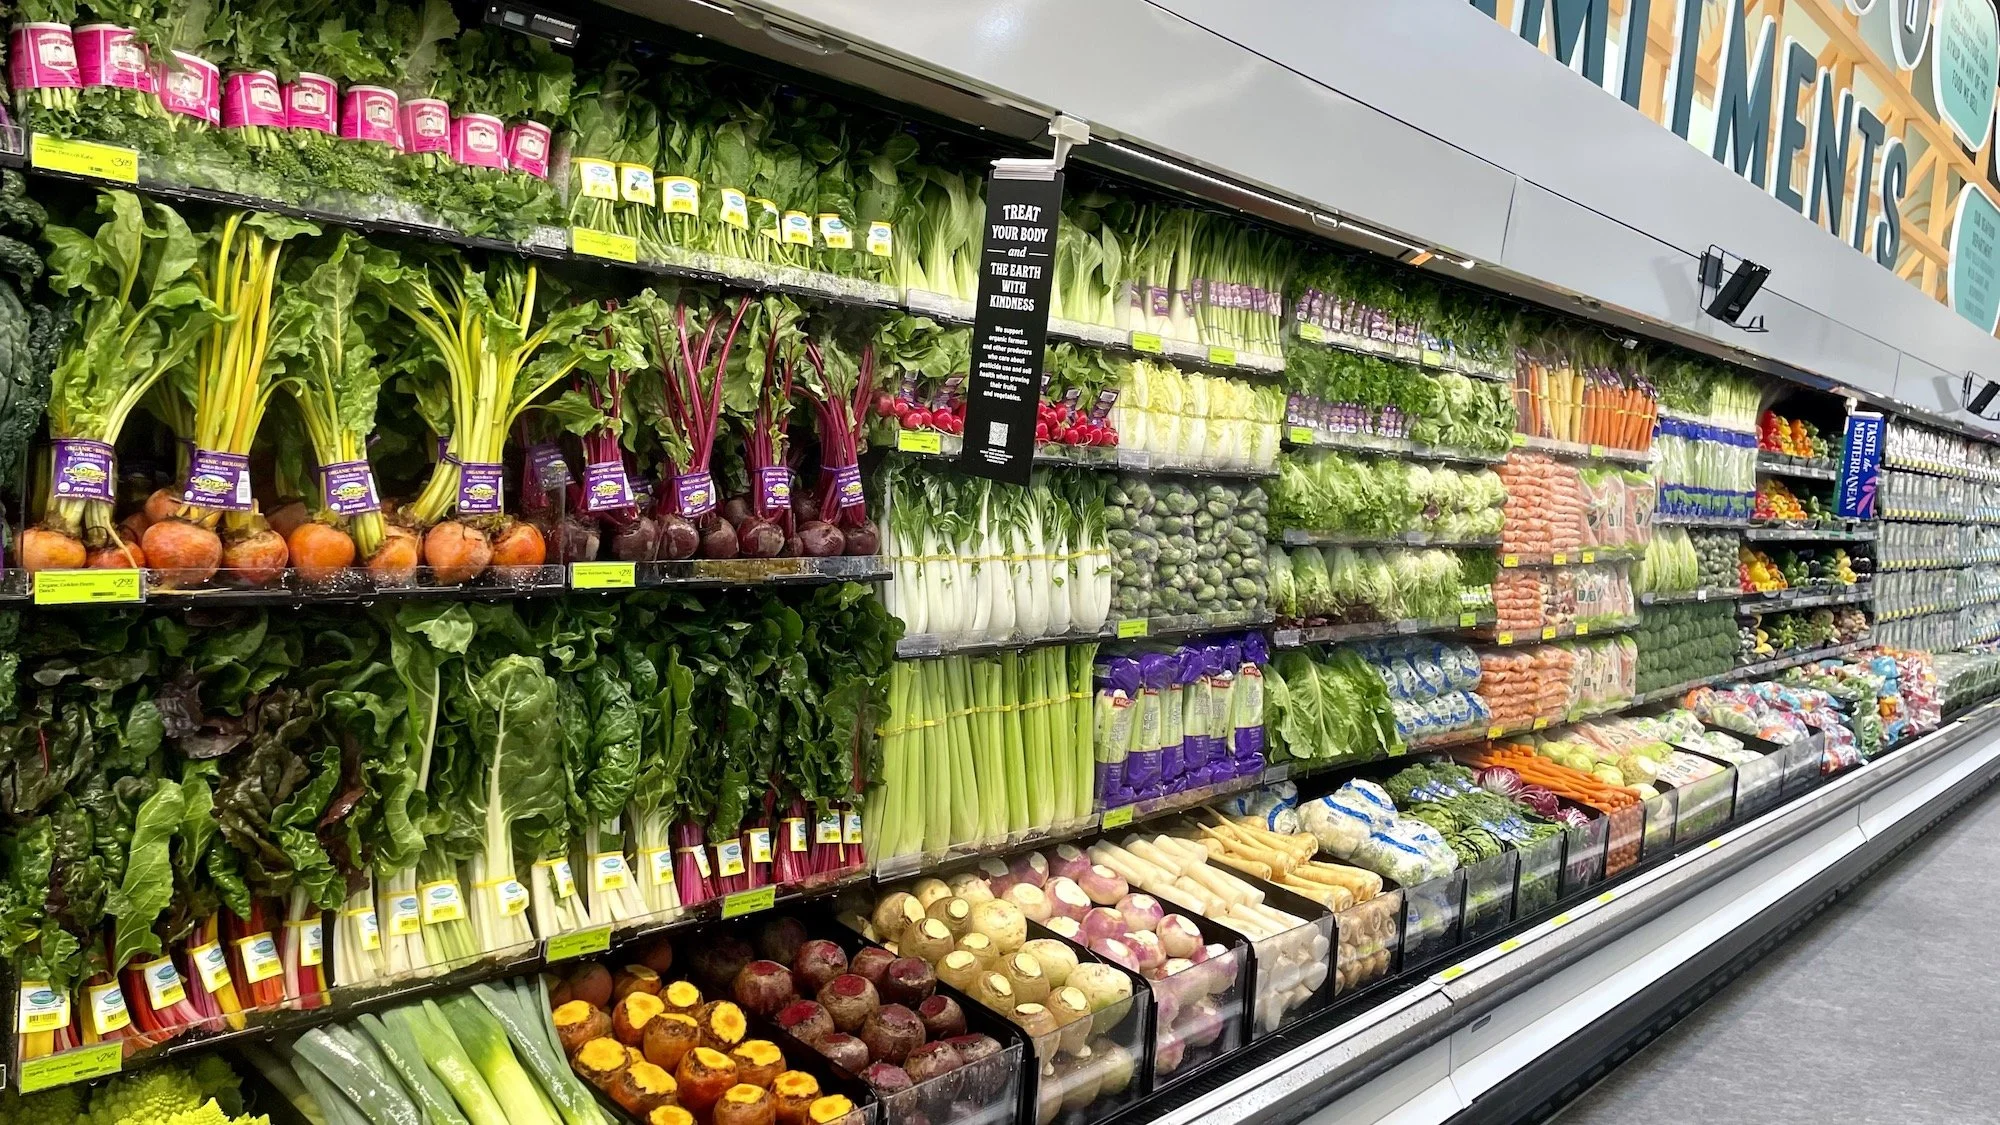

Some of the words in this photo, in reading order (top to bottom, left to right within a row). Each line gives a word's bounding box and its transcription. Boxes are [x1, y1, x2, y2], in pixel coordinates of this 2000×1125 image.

[1003, 204, 1041, 222] TREAT
[992, 224, 1019, 241] YOUR
[1020, 226, 1048, 243] BODY
[1007, 245, 1027, 258] and
[990, 261, 1008, 276] THE
[1009, 263, 1041, 280] EARTH
[1002, 279, 1027, 295] WITH
[989, 294, 1035, 312] KINDNESS
[995, 325, 1003, 333] We
[1003, 327, 1024, 336] support
[988, 335, 1007, 343] organic
[1007, 336, 1028, 345] farmers
[992, 344, 1007, 352] other
[1006, 347, 1033, 356] producers
[987, 353, 998, 361] who
[1010, 356, 1026, 364] about
[979, 361, 1001, 370] pesticide
[1022, 367, 1033, 375] soil
[979, 370, 996, 378] health
[996, 373, 1009, 381] when
[1010, 376, 1030, 385] growing
[989, 380, 1002, 389] their
[1002, 383, 1017, 391] fruits
[993, 391, 1022, 402] vegetables.
[1864, 422, 1879, 456] TASTE
[1845, 421, 1866, 510] MEDITERRANEAN
[1862, 457, 1873, 473] the
